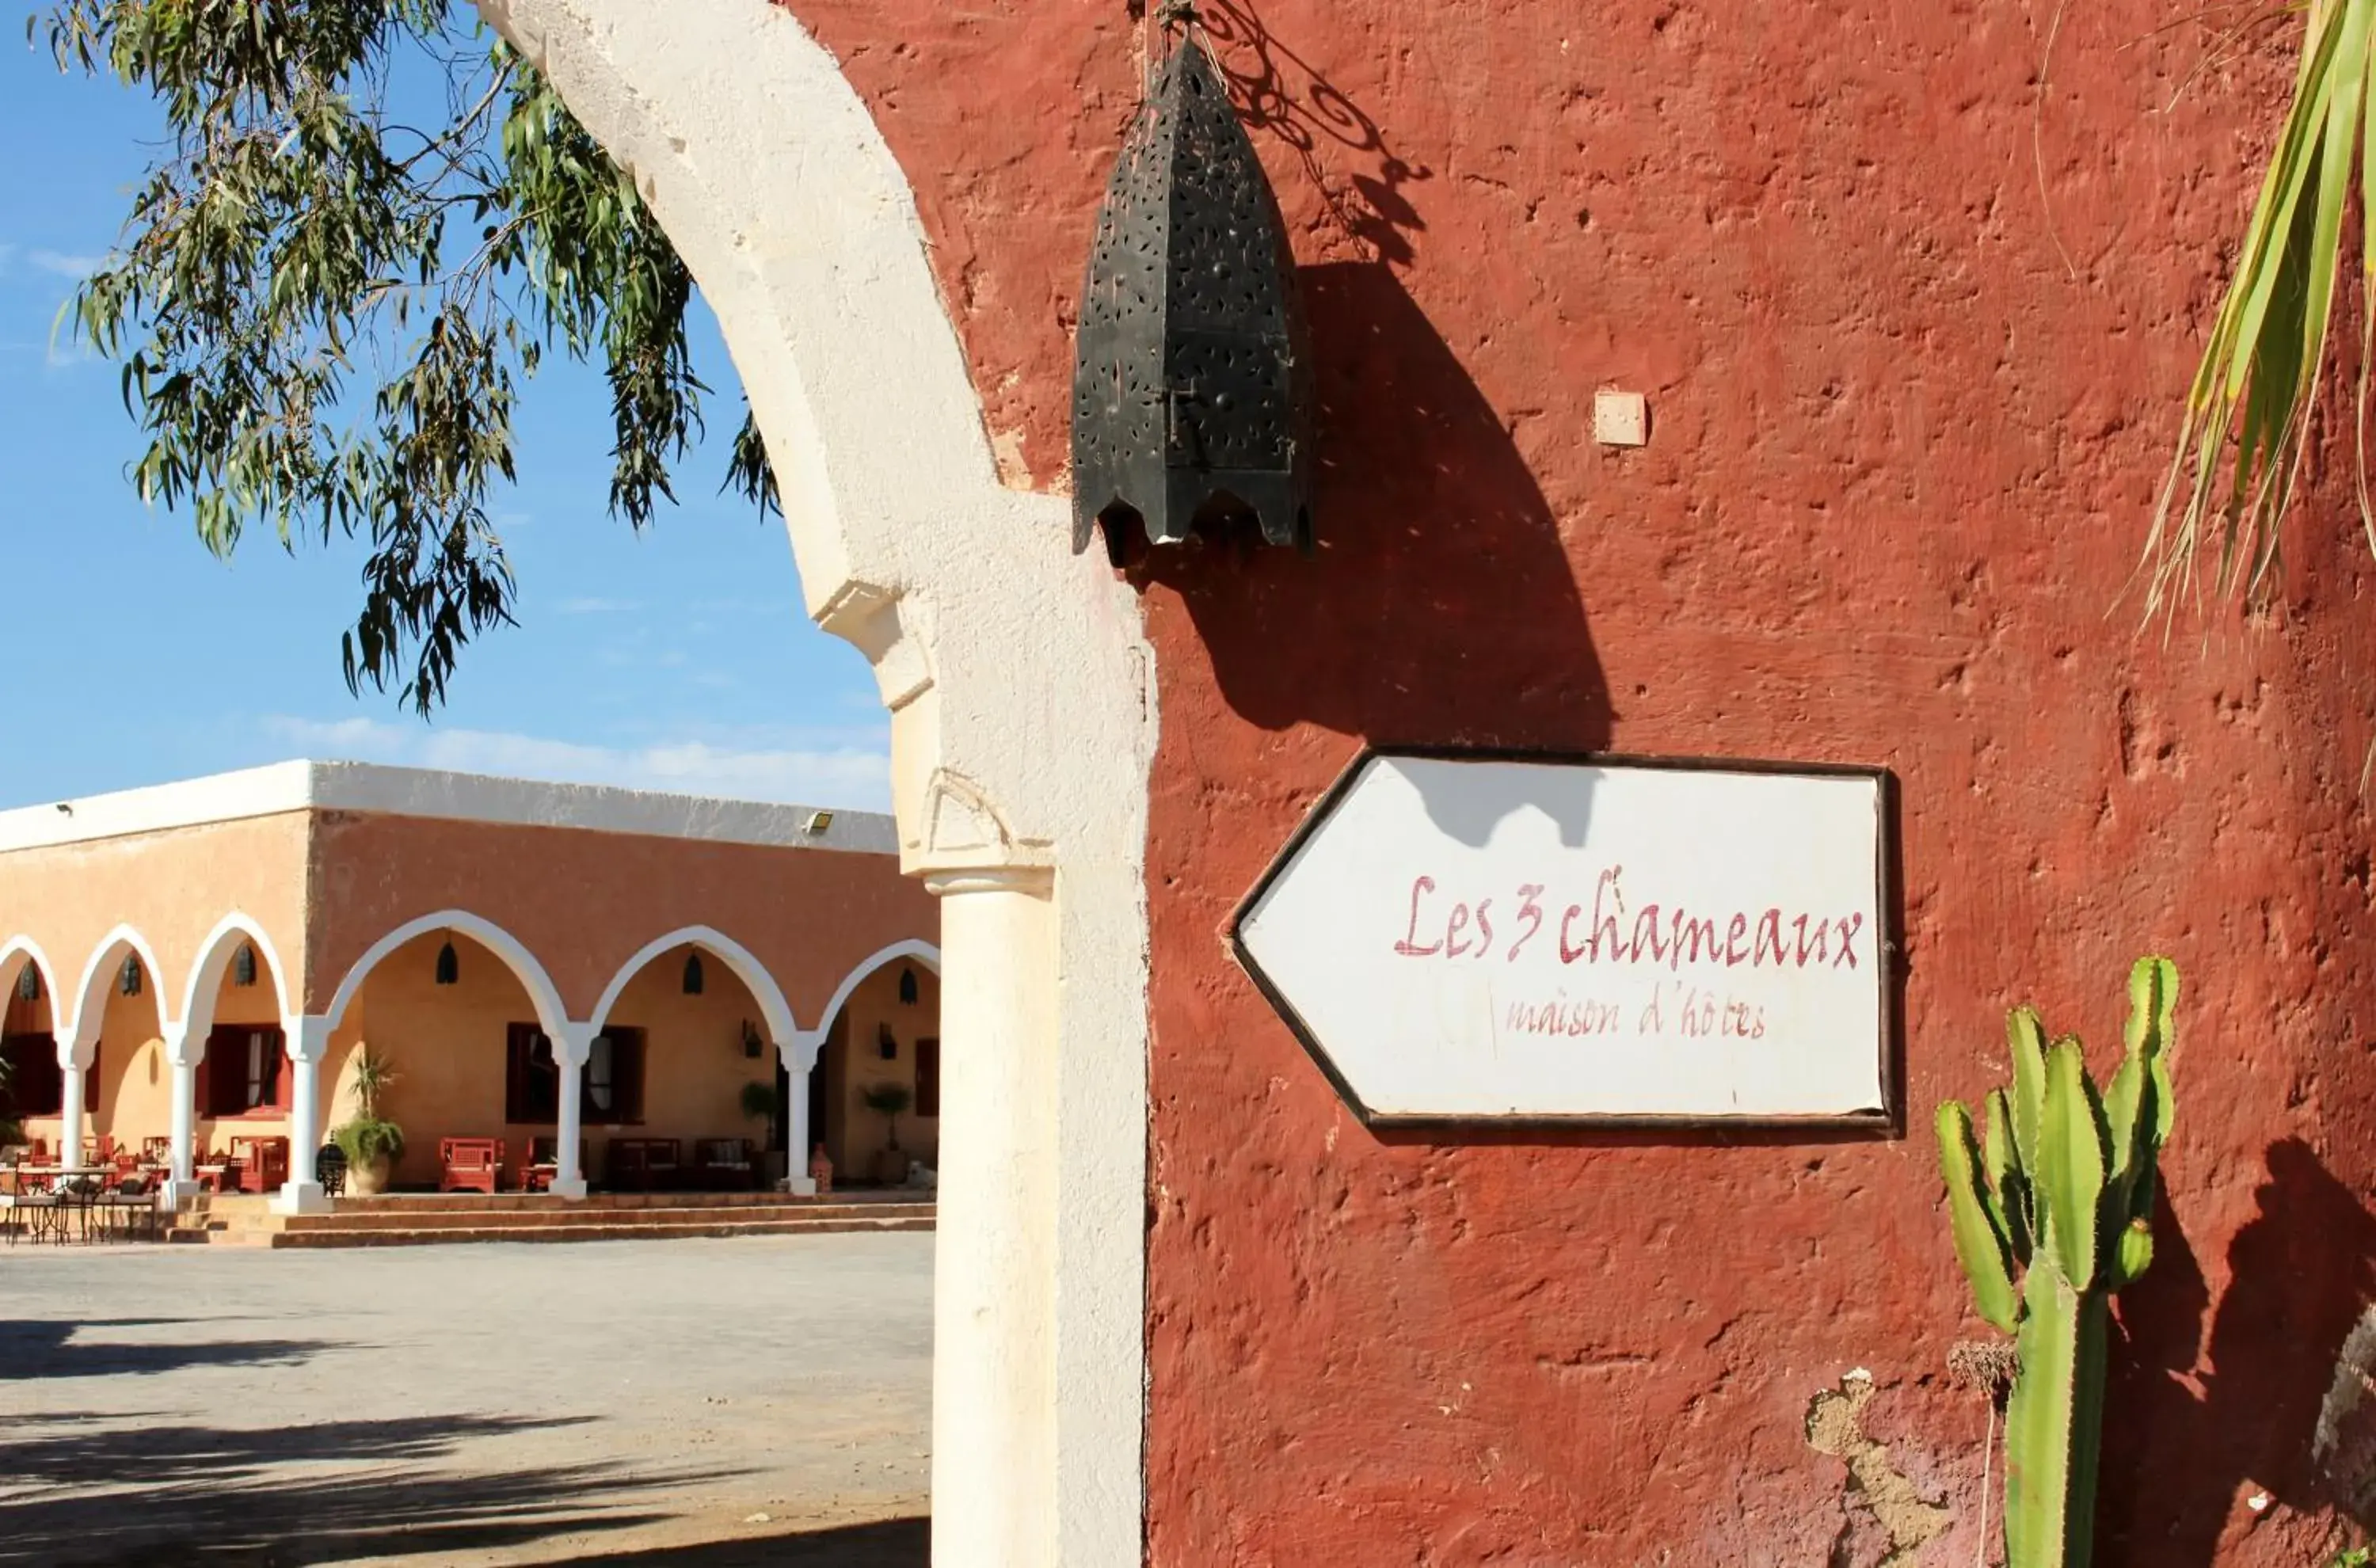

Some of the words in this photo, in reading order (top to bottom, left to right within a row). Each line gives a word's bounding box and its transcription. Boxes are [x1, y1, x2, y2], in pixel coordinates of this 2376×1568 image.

[1394, 875, 1494, 959] Les
[1507, 884, 1544, 963] 3
[1559, 865, 1863, 972] chameaux
[1506, 987, 1620, 1037] maison
